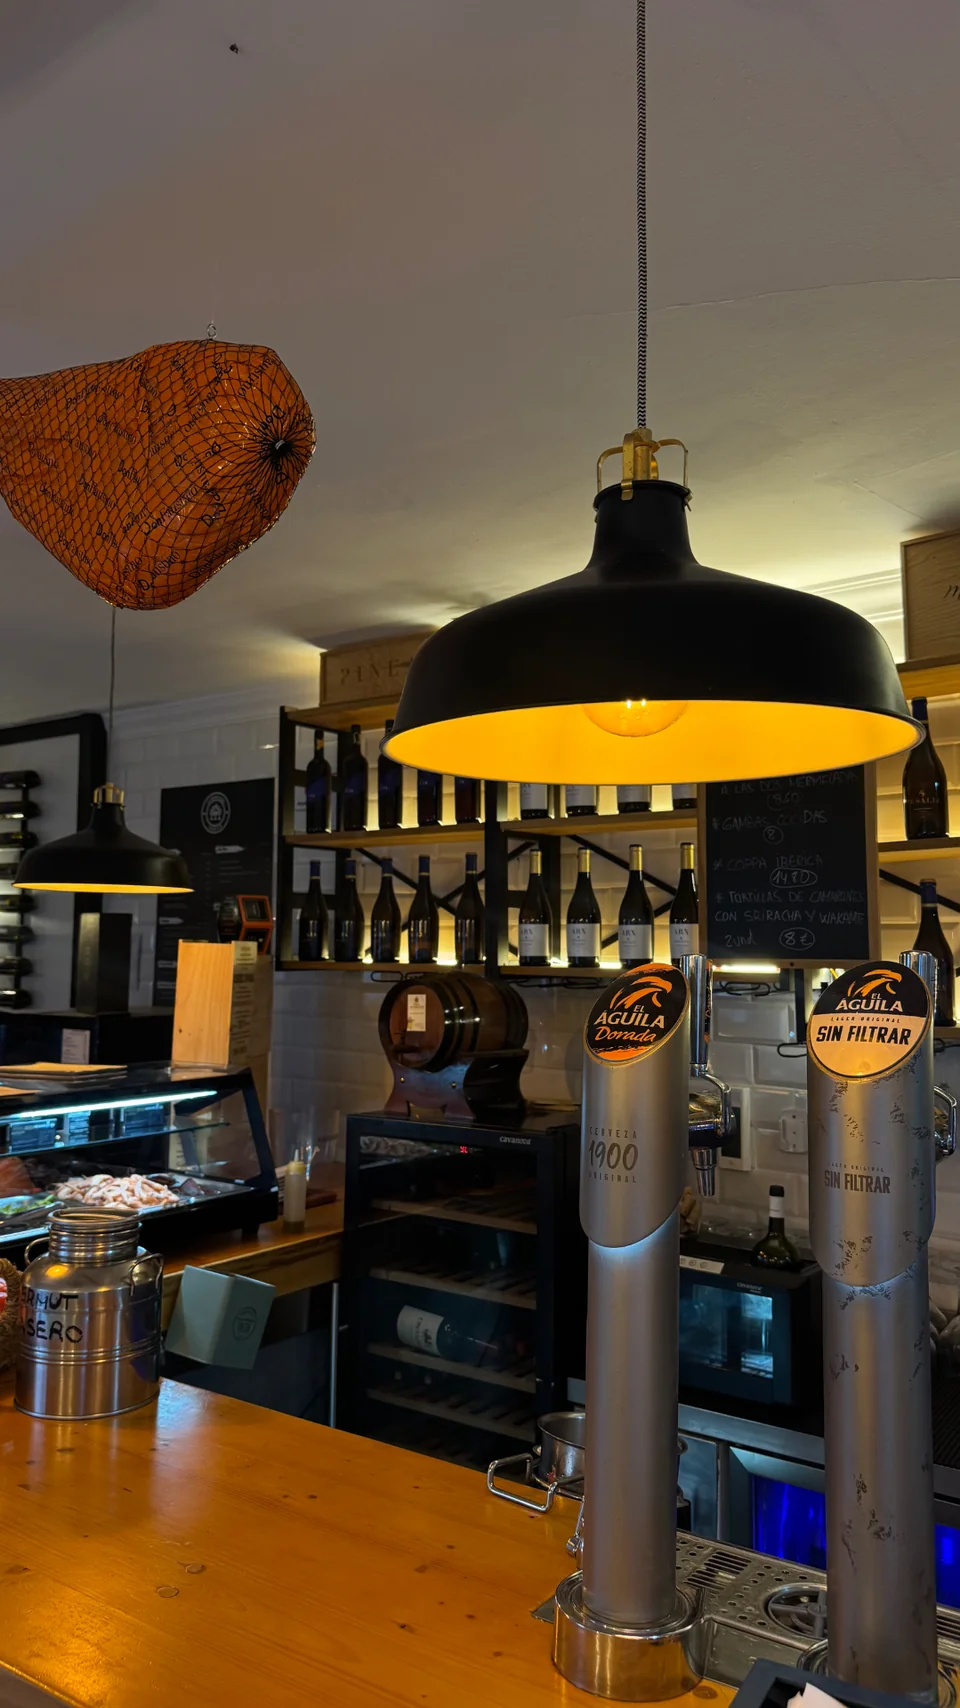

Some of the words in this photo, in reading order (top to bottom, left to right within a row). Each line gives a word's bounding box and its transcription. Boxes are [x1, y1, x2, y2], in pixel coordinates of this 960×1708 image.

[715, 911, 737, 922] CON
[804, 909, 816, 923] Y
[633, 1005, 645, 1013] EL
[835, 998, 904, 1012] ÁGUILA
[593, 1010, 665, 1029] ÁGUILA
[595, 1026, 657, 1042] Dorada
[816, 1025, 844, 1042] SIN
[847, 1025, 912, 1045] FILTRAR
[589, 1126, 637, 1139] CERVEZA
[588, 1139, 639, 1171] 1900
[588, 1171, 637, 1184] ORIGINAL
[824, 1170, 841, 1189] SIN
[844, 1172, 891, 1194] FILTRAR
[27, 1288, 78, 1310] RMUT
[23, 1318, 84, 1344] SERO
